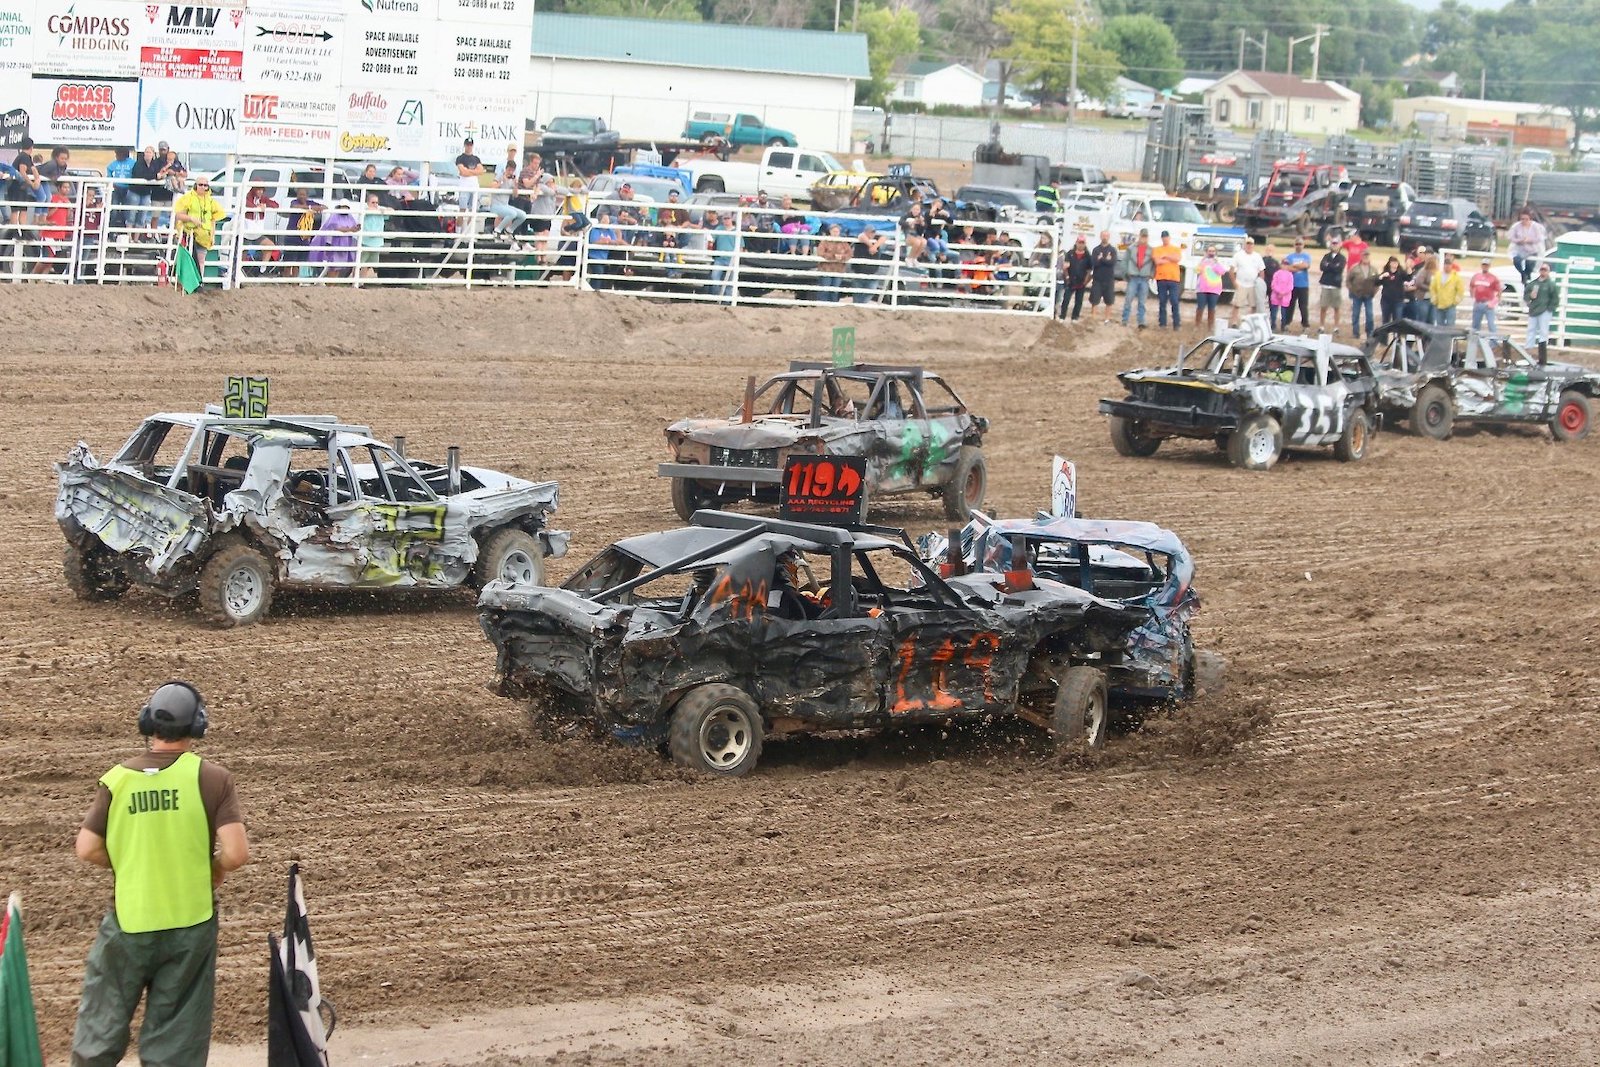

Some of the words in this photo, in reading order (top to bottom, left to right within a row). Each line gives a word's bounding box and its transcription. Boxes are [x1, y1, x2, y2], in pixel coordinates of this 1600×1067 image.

[376, 0, 419, 12] Nutrena
[503, 0, 515, 10] 222
[166, 5, 221, 28] MW
[47, 14, 130, 36] COMPASS
[273, 21, 321, 44] COLT
[365, 31, 386, 42] SPACE
[387, 32, 419, 43] AVAILABLE
[72, 37, 129, 51] HEDGING
[456, 36, 477, 47] SPACE
[479, 38, 512, 49] AVAILABLE
[365, 47, 417, 59] ADVERTISEMENT
[456, 52, 509, 64] ADVERTISEMENT
[260, 69, 282, 81] (970)
[406, 65, 418, 75] 222
[499, 70, 511, 80] 222
[58, 84, 113, 103] GREASE
[348, 91, 388, 110] Buffalo
[53, 101, 115, 121] MONKEY
[280, 101, 308, 110] WICKHAM
[309, 102, 336, 112] TRACTOR
[175, 101, 236, 130] ONEOK
[61, 123, 89, 132] Changes
[244, 126, 272, 137] FARM
[278, 127, 304, 138] FEED
[311, 129, 331, 140] FUN
[436, 121, 462, 138] TBK
[481, 123, 518, 141] BANK
[224, 377, 268, 418] 22
[788, 461, 836, 497] 119
[889, 631, 1001, 713] 119
[128, 788, 179, 815] JUDGE
